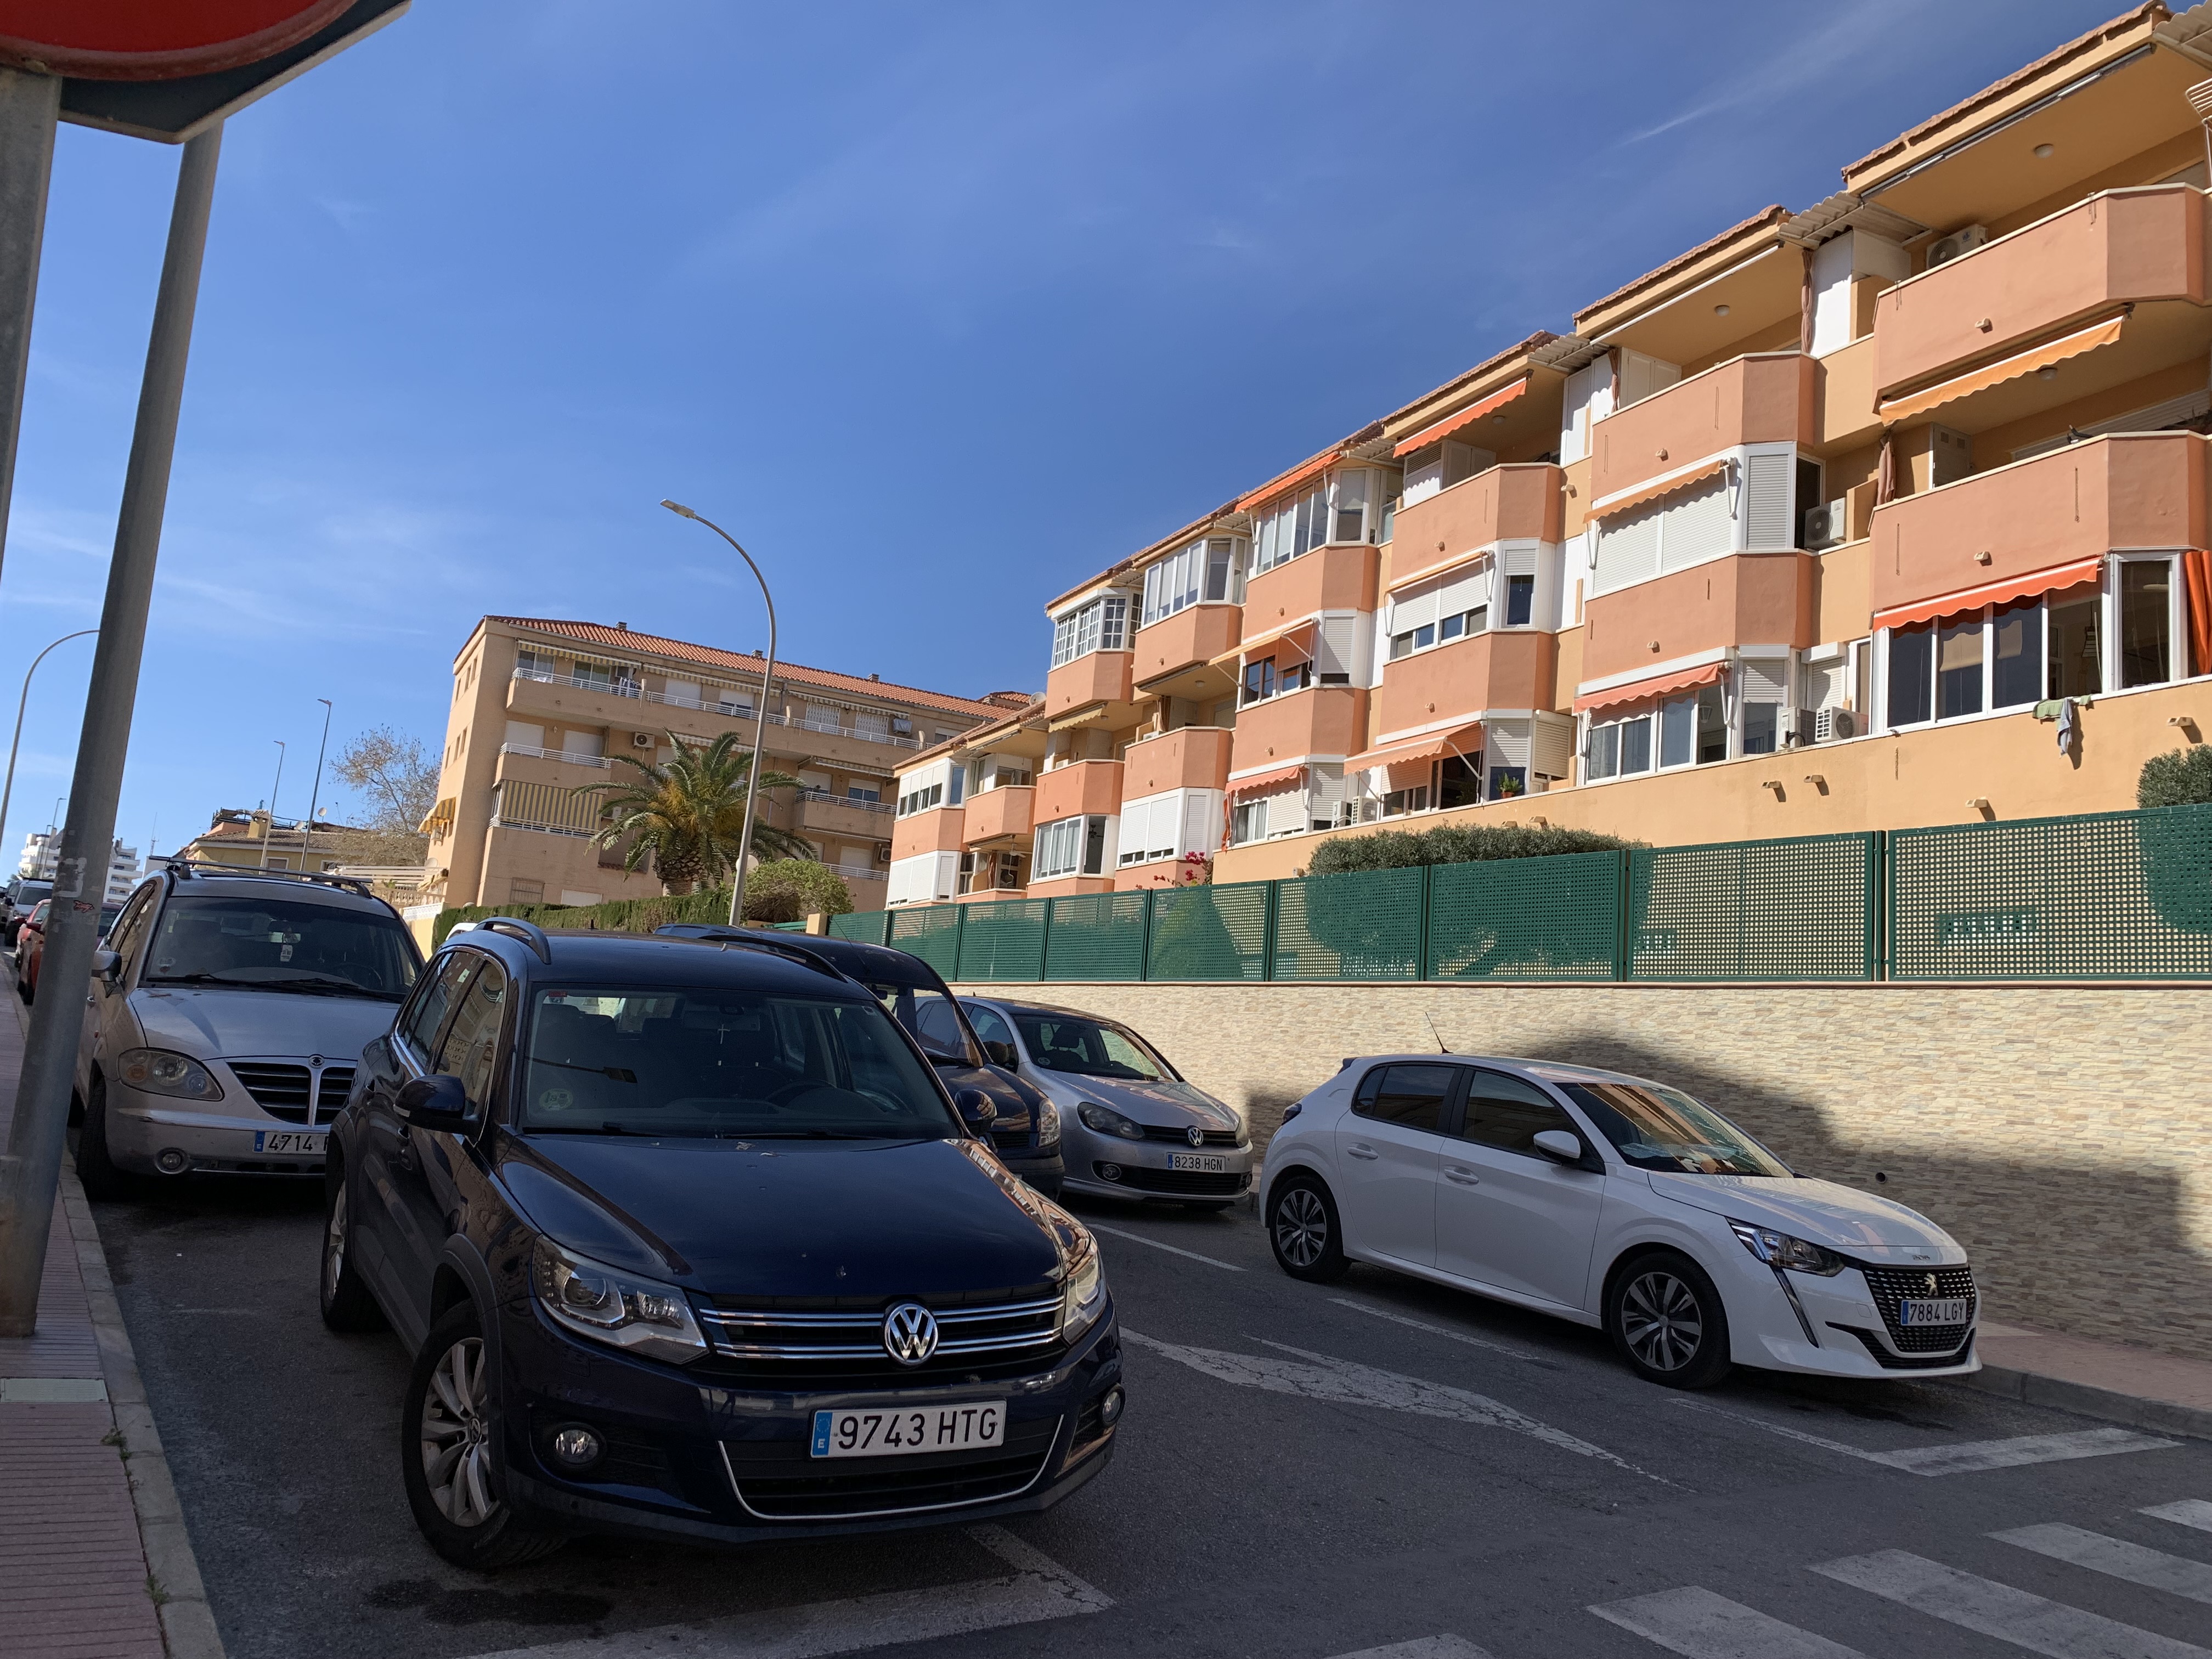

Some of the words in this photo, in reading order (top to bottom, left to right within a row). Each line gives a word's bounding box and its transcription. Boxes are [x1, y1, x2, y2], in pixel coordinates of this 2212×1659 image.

[269, 1135, 313, 1152] 4714
[1175, 1156, 1201, 1170] 8238
[1204, 1158, 1222, 1171] HGN
[1910, 1303, 1940, 1322] 7884
[1944, 1302, 1964, 1321] LGY
[817, 1438, 825, 1449] E
[838, 1413, 925, 1449] 9743
[937, 1408, 997, 1444] HTG
